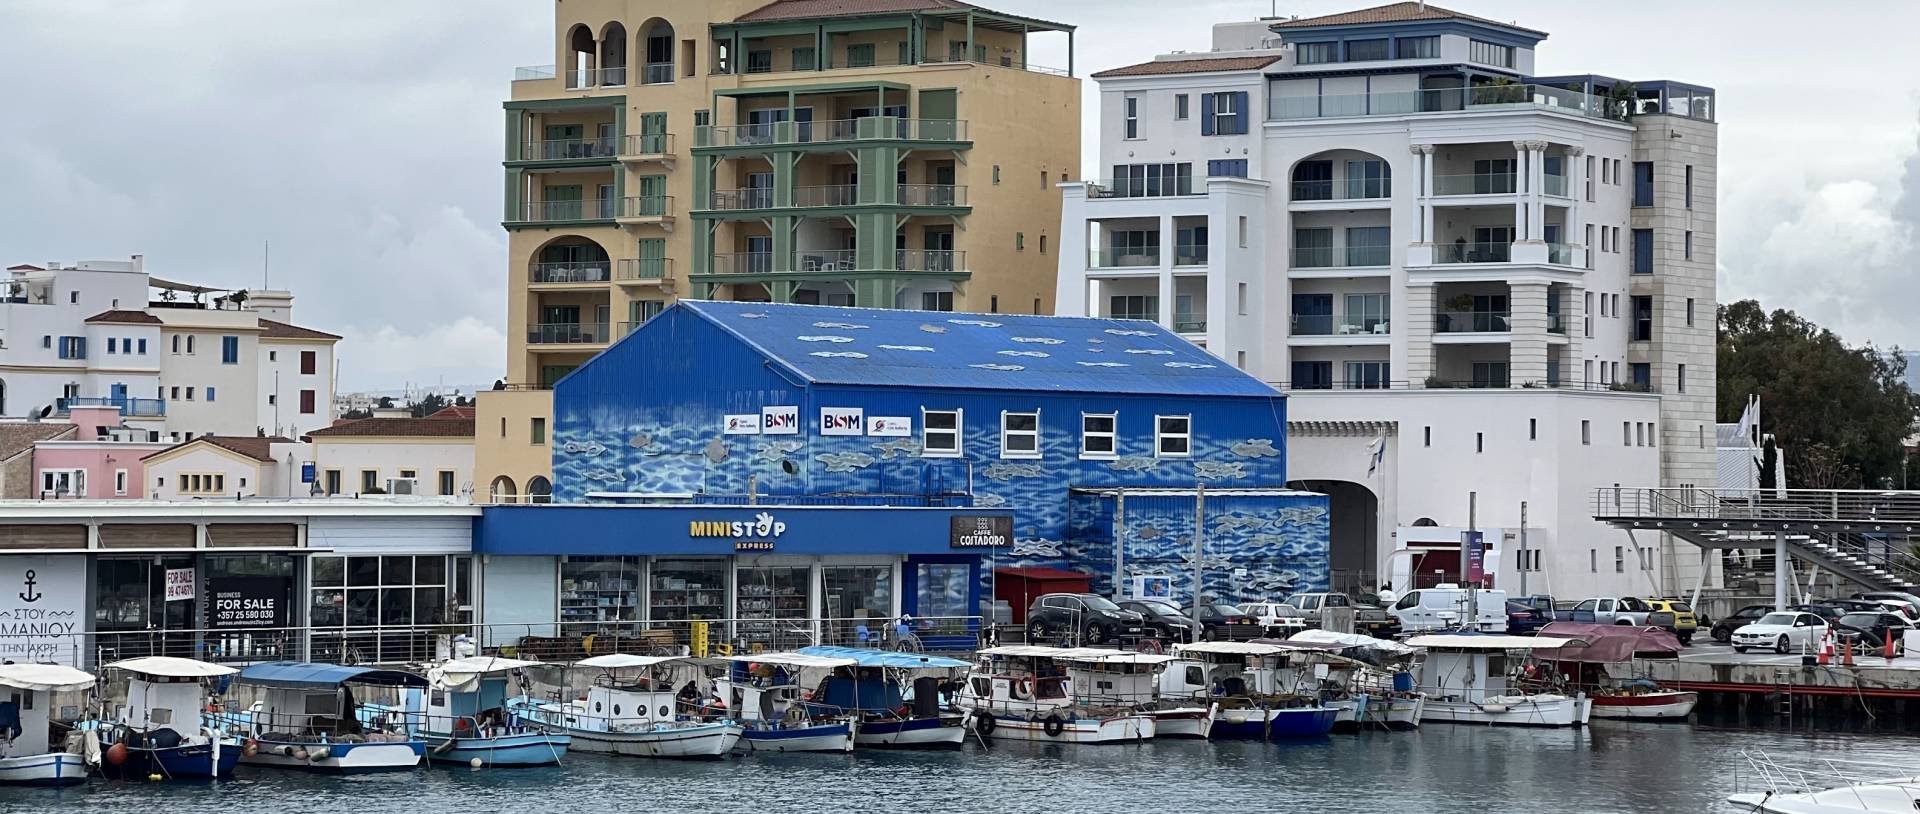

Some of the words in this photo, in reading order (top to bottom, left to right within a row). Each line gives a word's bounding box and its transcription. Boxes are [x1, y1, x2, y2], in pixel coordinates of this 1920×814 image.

[690, 512, 786, 537] MINISTOP
[960, 536, 1005, 546] COSTADORO
[168, 572, 178, 584] FOR
[180, 571, 192, 583] SALE
[168, 586, 174, 597] 99
[217, 600, 240, 610] FOR
[244, 599, 274, 609] SALE
[14, 609, 45, 619] ΣΤΟΥ
[217, 611, 234, 619] +357
[235, 611, 244, 619] 25
[246, 611, 259, 619] 580
[260, 610, 274, 619] 030
[29, 643, 58, 652] ΑΚΡΗ
